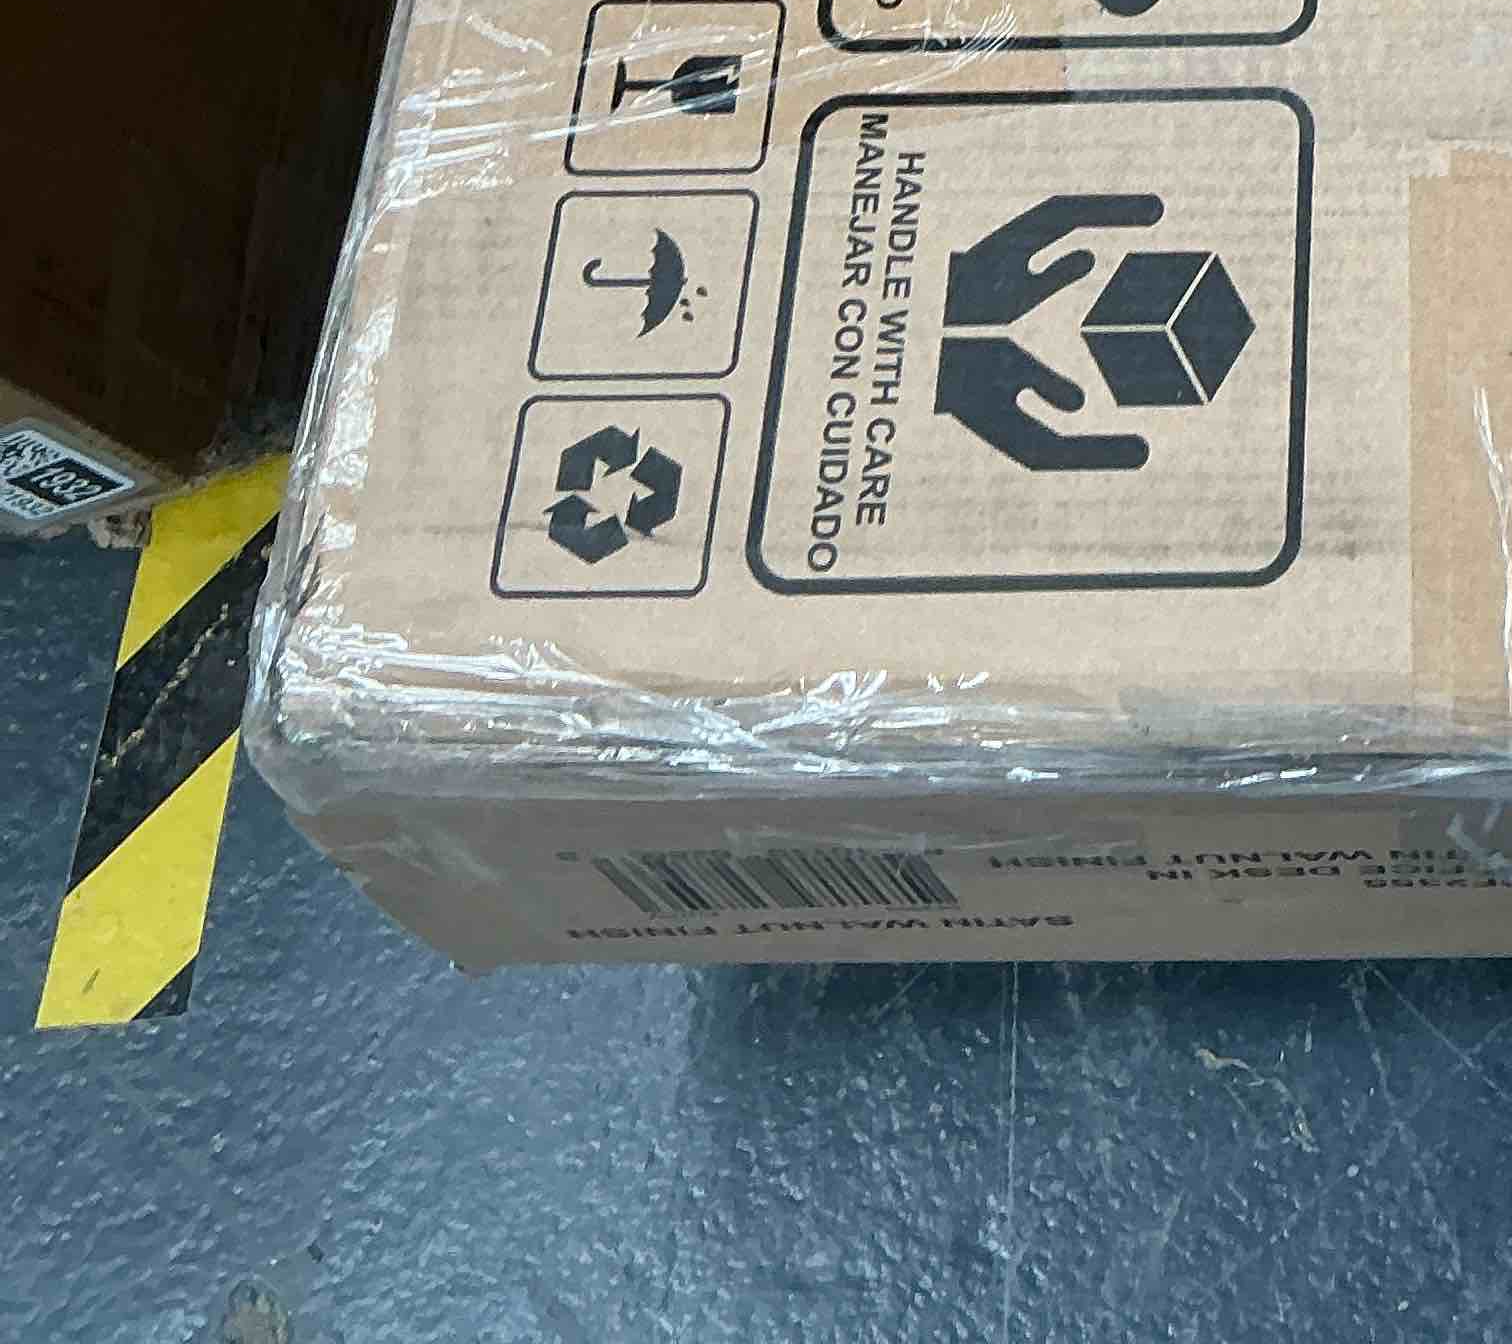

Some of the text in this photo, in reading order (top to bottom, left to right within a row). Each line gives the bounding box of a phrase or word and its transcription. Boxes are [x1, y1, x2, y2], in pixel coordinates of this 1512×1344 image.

[807, 114, 889, 573] MANEJAR CON CUIDADO
[855, 152, 926, 528] HANDLE WITH CARE
[1166, 850, 1374, 864] WALNUT
[1145, 869, 1196, 881] IN
[1207, 865, 1342, 878] DESK
[565, 915, 1075, 939] SATIN WALNUT FINISH
